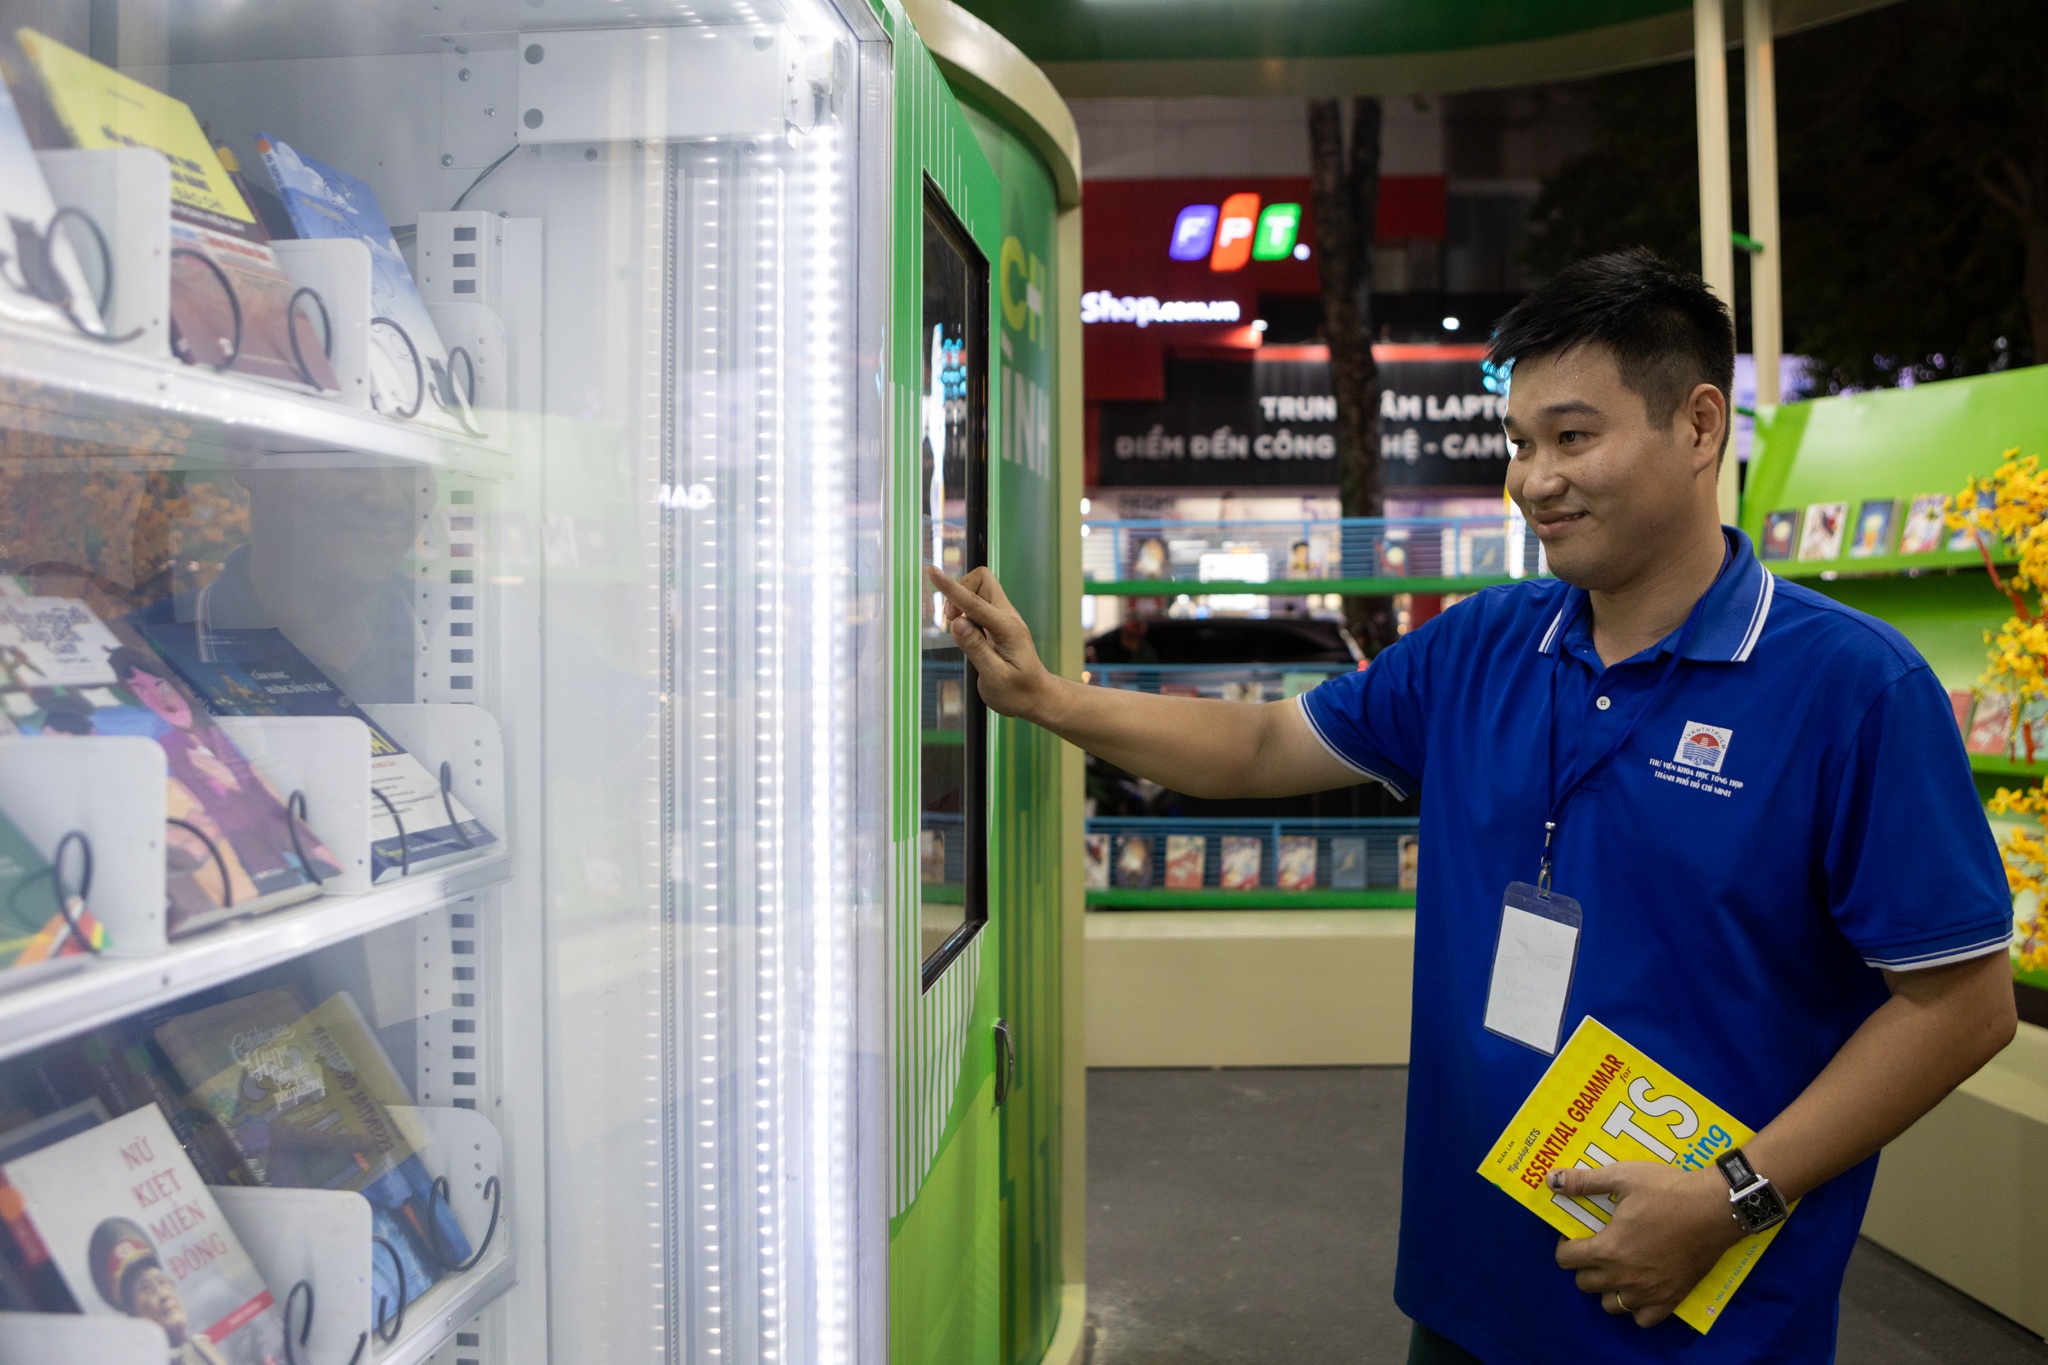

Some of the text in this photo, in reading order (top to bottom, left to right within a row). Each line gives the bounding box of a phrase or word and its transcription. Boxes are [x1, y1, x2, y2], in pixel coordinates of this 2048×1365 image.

[1259, 396, 1338, 421] TRUN
[1380, 389, 1422, 421] ÂM
[1253, 428, 1337, 459] CÔNG
[1442, 433, 1507, 460] CAM
[1677, 764, 1694, 776] KHOA
[1695, 769, 1710, 781] HỌC
[1619, 1066, 1632, 1084] for
[1520, 1053, 1625, 1190] ESSENTIAL GRAMMAR
[1506, 1140, 1515, 1151] LAN
[1524, 1128, 1541, 1147] IELTS
[1675, 1124, 1732, 1172] iting
